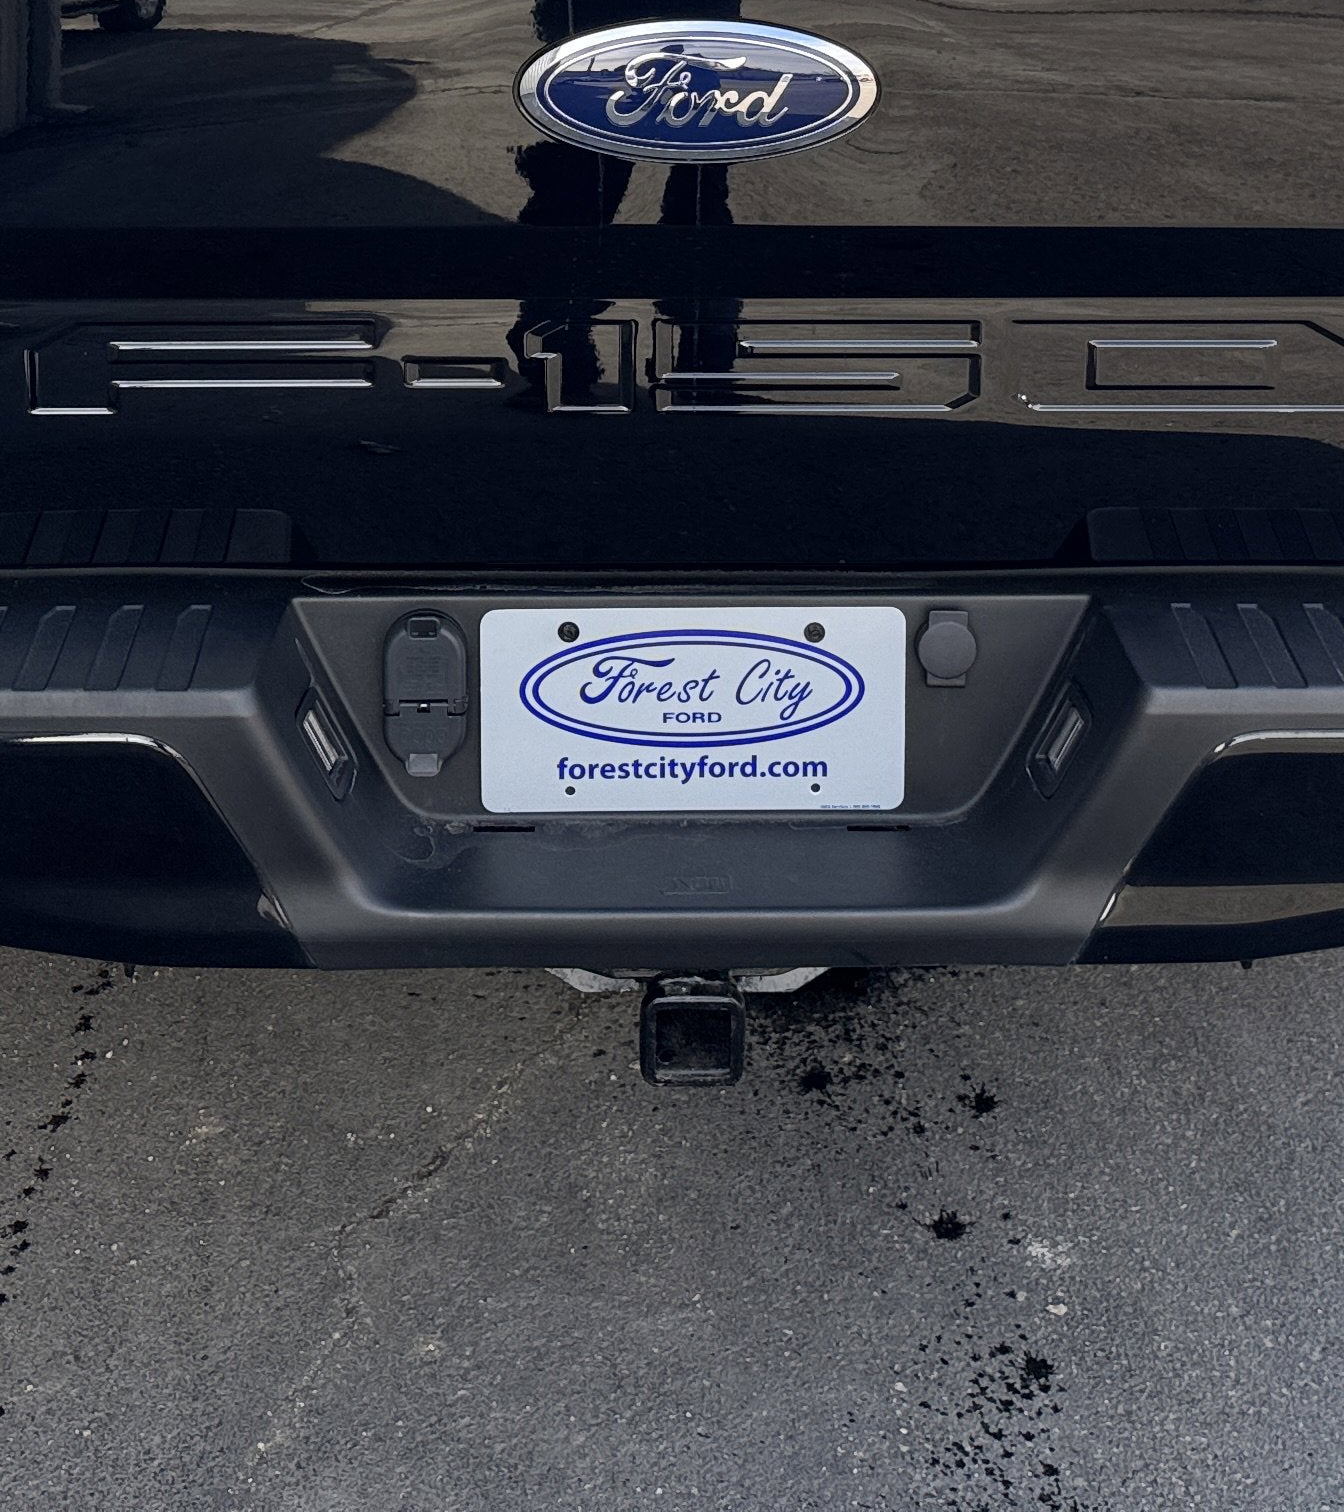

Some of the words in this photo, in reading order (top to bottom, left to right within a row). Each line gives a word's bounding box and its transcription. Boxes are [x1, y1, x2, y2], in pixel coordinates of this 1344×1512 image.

[605, 51, 794, 128] Ford
[579, 655, 721, 705] Forest
[735, 658, 814, 722] City
[662, 711, 723, 724] FORD
[556, 754, 829, 785] forestcityford.com
